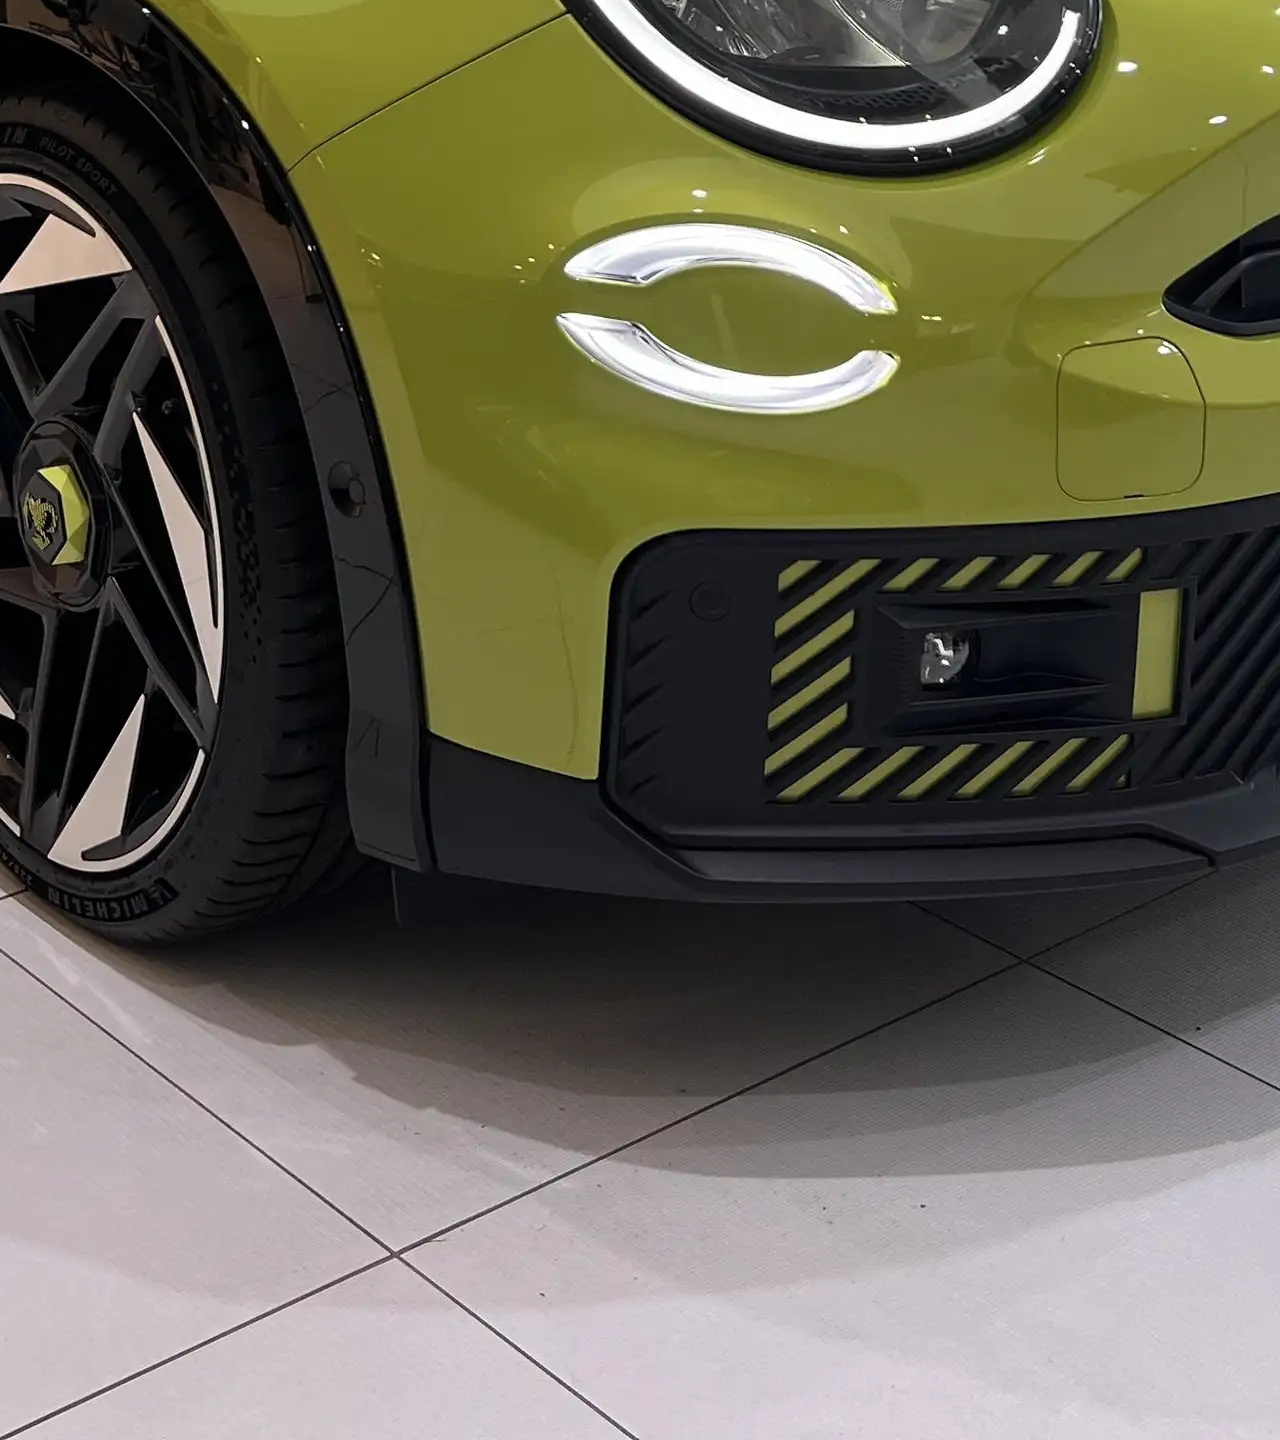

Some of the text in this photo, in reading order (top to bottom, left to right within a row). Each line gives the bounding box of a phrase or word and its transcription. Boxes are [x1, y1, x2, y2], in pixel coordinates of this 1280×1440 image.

[38, 136, 76, 161] PILOT
[76, 157, 120, 197] SPORT
[47, 887, 149, 922] MICHELIN
